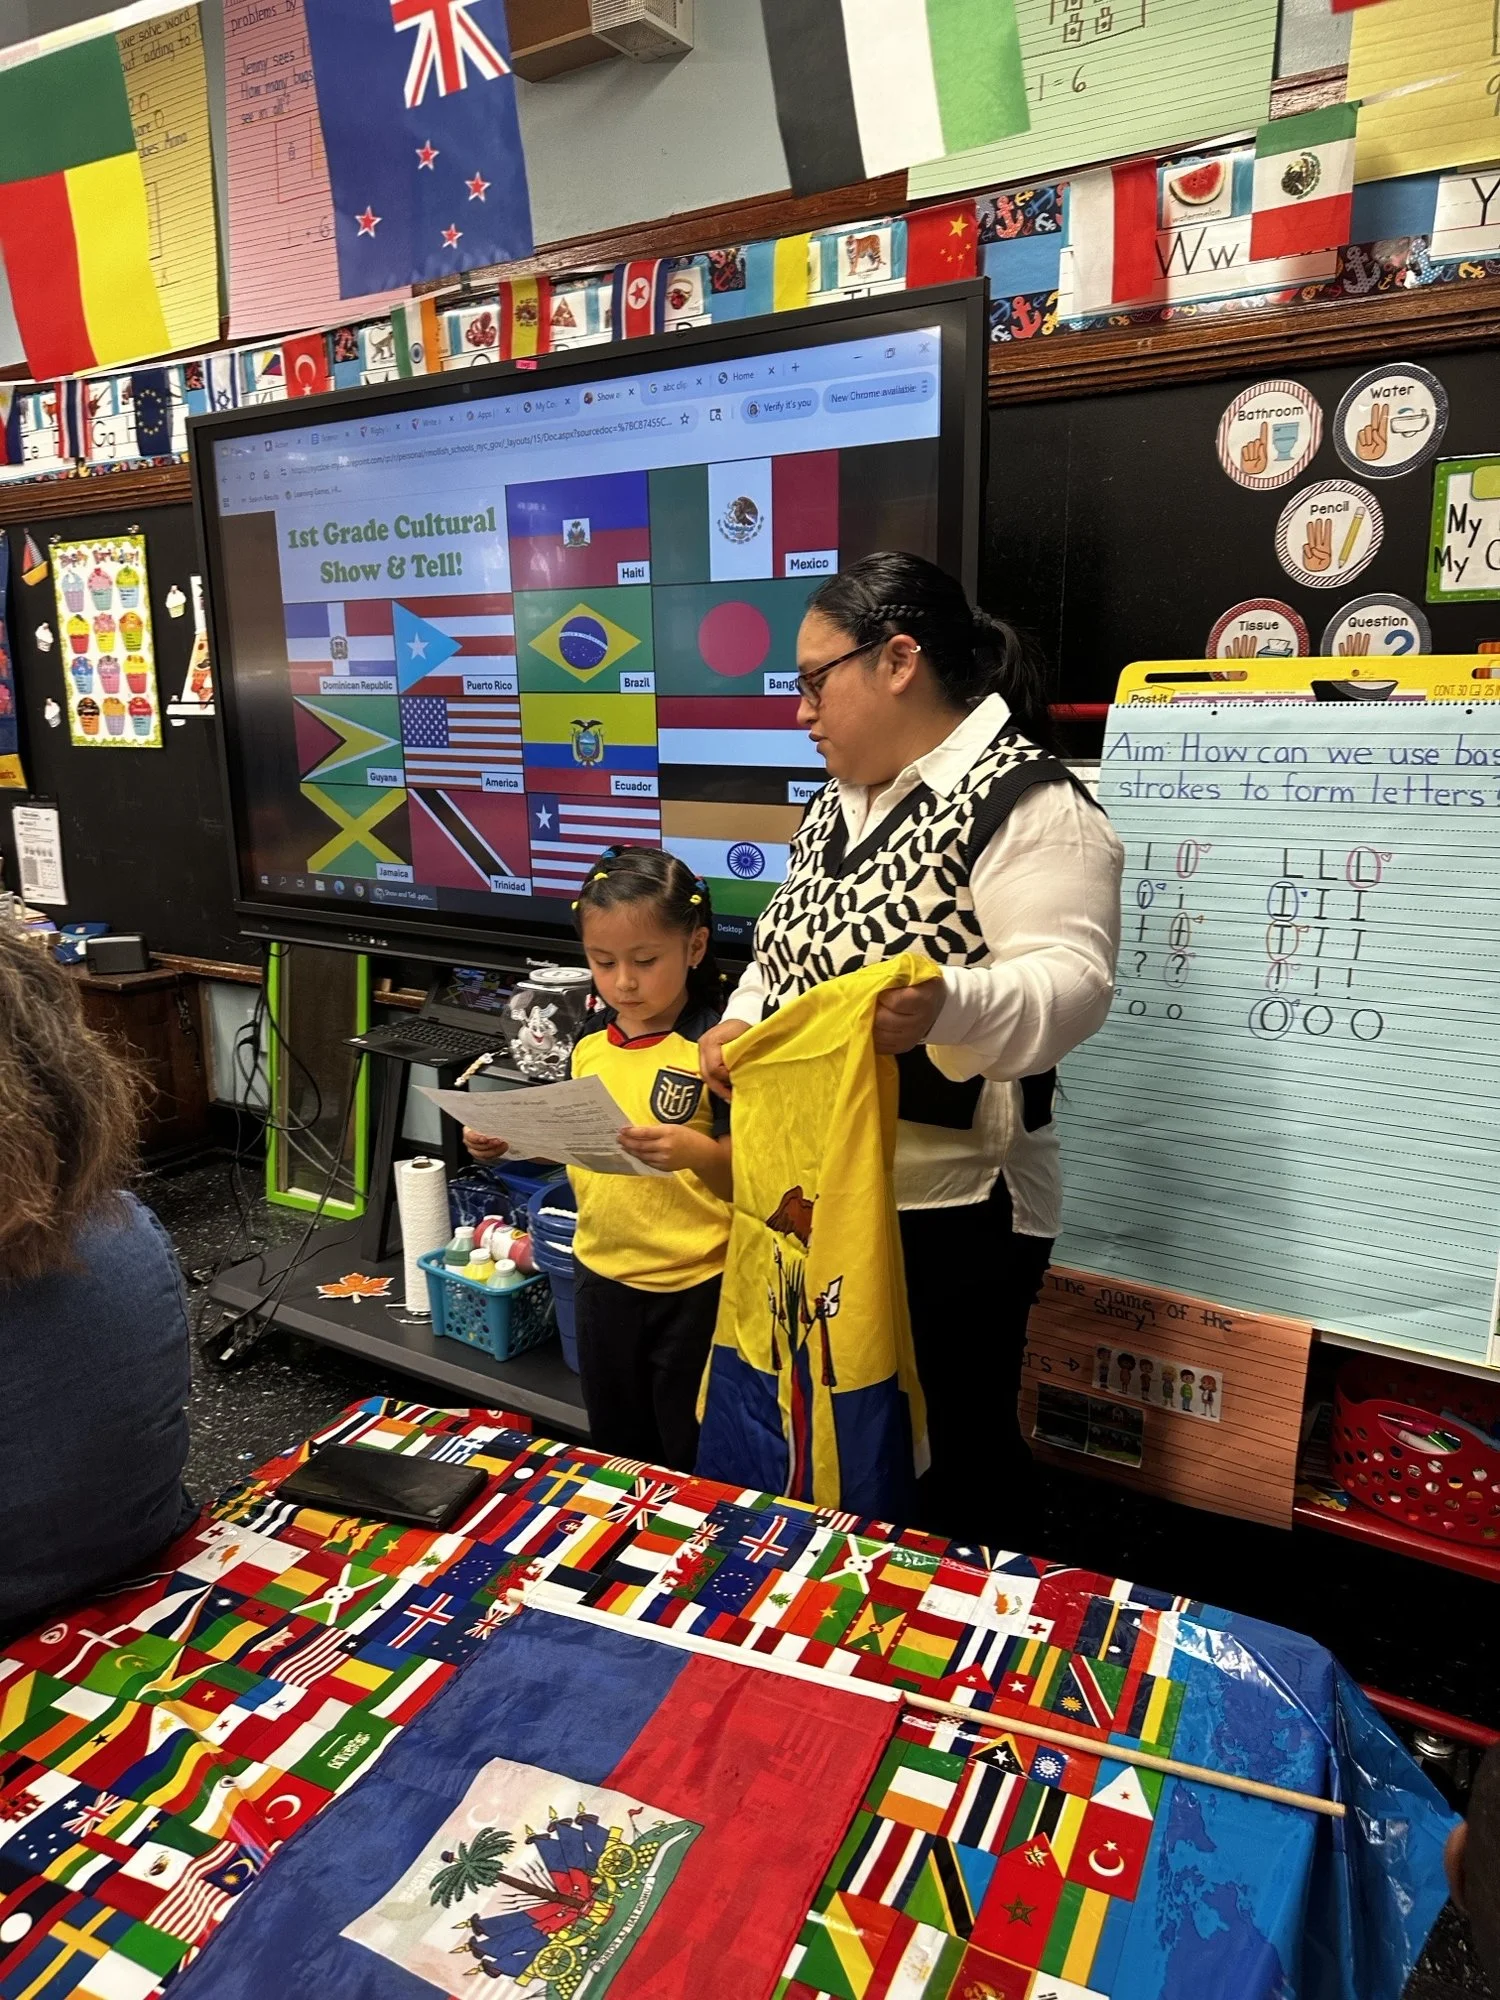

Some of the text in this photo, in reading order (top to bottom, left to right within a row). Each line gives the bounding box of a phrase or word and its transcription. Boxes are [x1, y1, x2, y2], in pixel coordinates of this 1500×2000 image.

[231, 5, 277, 37] problems
[273, 50, 295, 67] sees
[1072, 65, 1087, 93] 6
[1172, 206, 1223, 224] watermelon
[733, 370, 754, 381] Home
[831, 384, 917, 403] New Chrome available
[1371, 384, 1415, 400] Water
[764, 399, 784, 412] Verify
[798, 399, 812, 410] you
[1237, 403, 1304, 422] Bathroom
[1310, 500, 1350, 515] Pencil
[288, 507, 497, 549] 1st Grade Cultural
[1447, 503, 1482, 548] My
[320, 552, 463, 584] Show & Tell!
[790, 557, 829, 571] Mexico
[1433, 545, 1469, 582] My
[622, 567, 645, 579] Haiti
[1238, 619, 1280, 632] Tissue
[1348, 615, 1409, 629] Question
[322, 679, 393, 692] Dominican Republic
[466, 680, 513, 692] Puerto Rico
[624, 677, 651, 688] Brazil
[769, 677, 799, 691] Bangl
[1131, 694, 1168, 704] Post-it
[1107, 731, 1172, 763] Aim:
[1180, 732, 1247, 764] How
[1257, 748, 1308, 764] can
[1329, 750, 1373, 765] we
[1389, 750, 1440, 766] use
[370, 772, 398, 783] Guyana
[485, 777, 519, 788] America
[614, 780, 652, 793] Ecuador
[793, 787, 816, 798] Yem
[1119, 769, 1221, 801] strokes
[1240, 772, 1270, 801] to
[1282, 772, 1354, 803] form
[1372, 773, 1486, 807] letters
[379, 868, 409, 879] Jamaica
[493, 880, 526, 892] Trinidad
[717, 923, 743, 935] Desktop
[1051, 1276, 1233, 1333] The name of the
